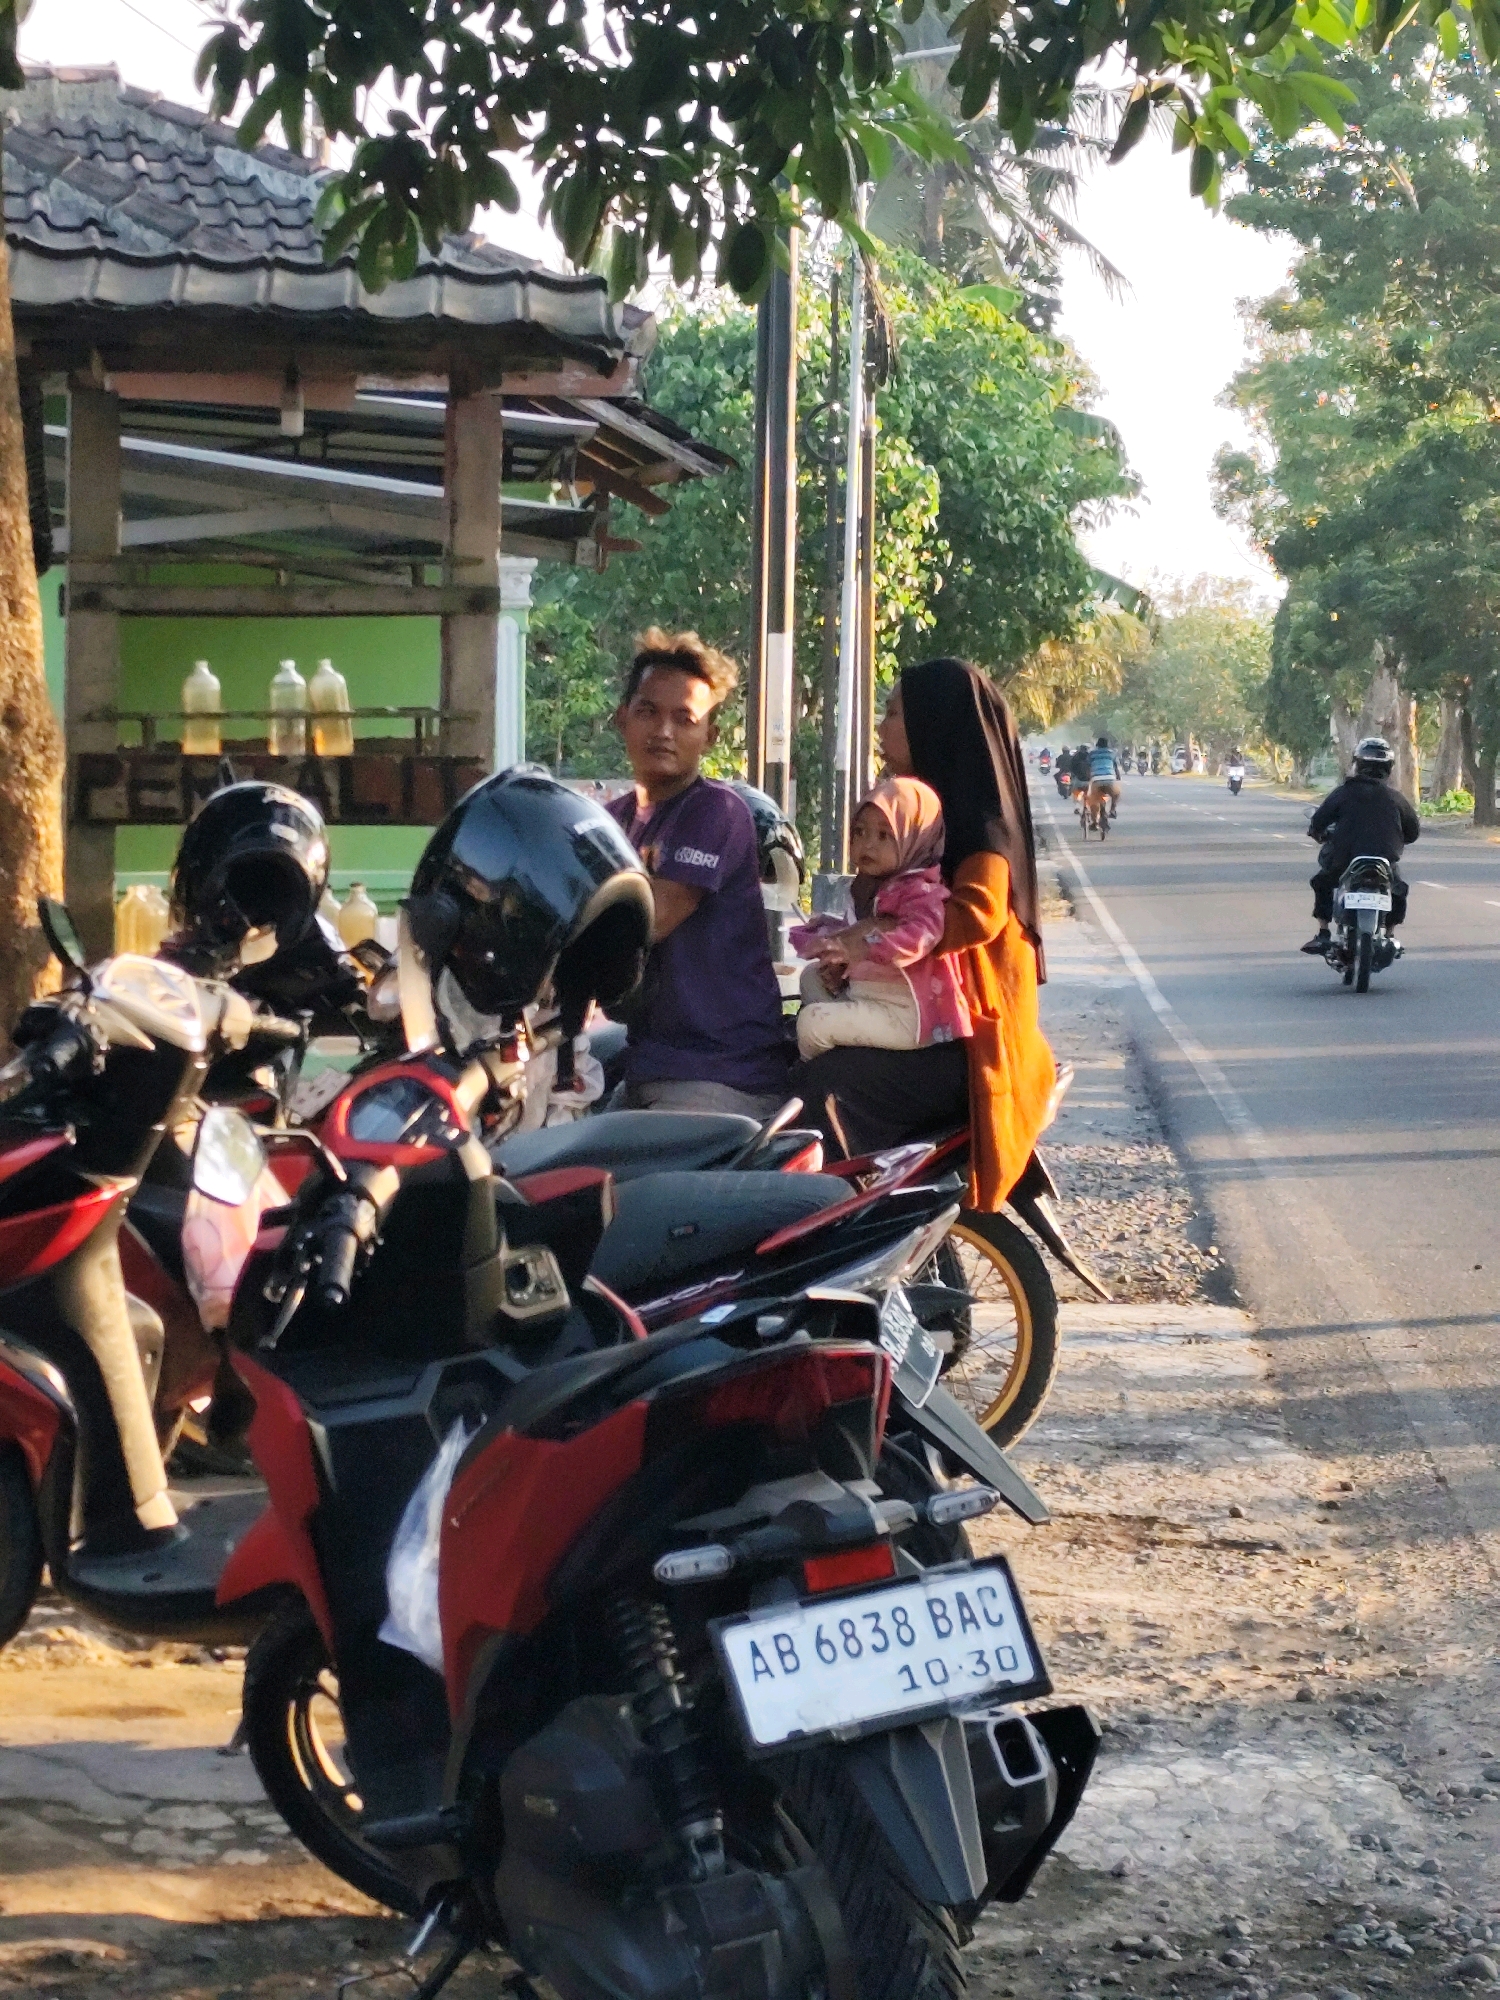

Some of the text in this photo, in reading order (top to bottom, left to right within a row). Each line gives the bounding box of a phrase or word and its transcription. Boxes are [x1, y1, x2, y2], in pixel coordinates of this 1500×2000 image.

[750, 1586, 1004, 1682] AB 6838 BAC
